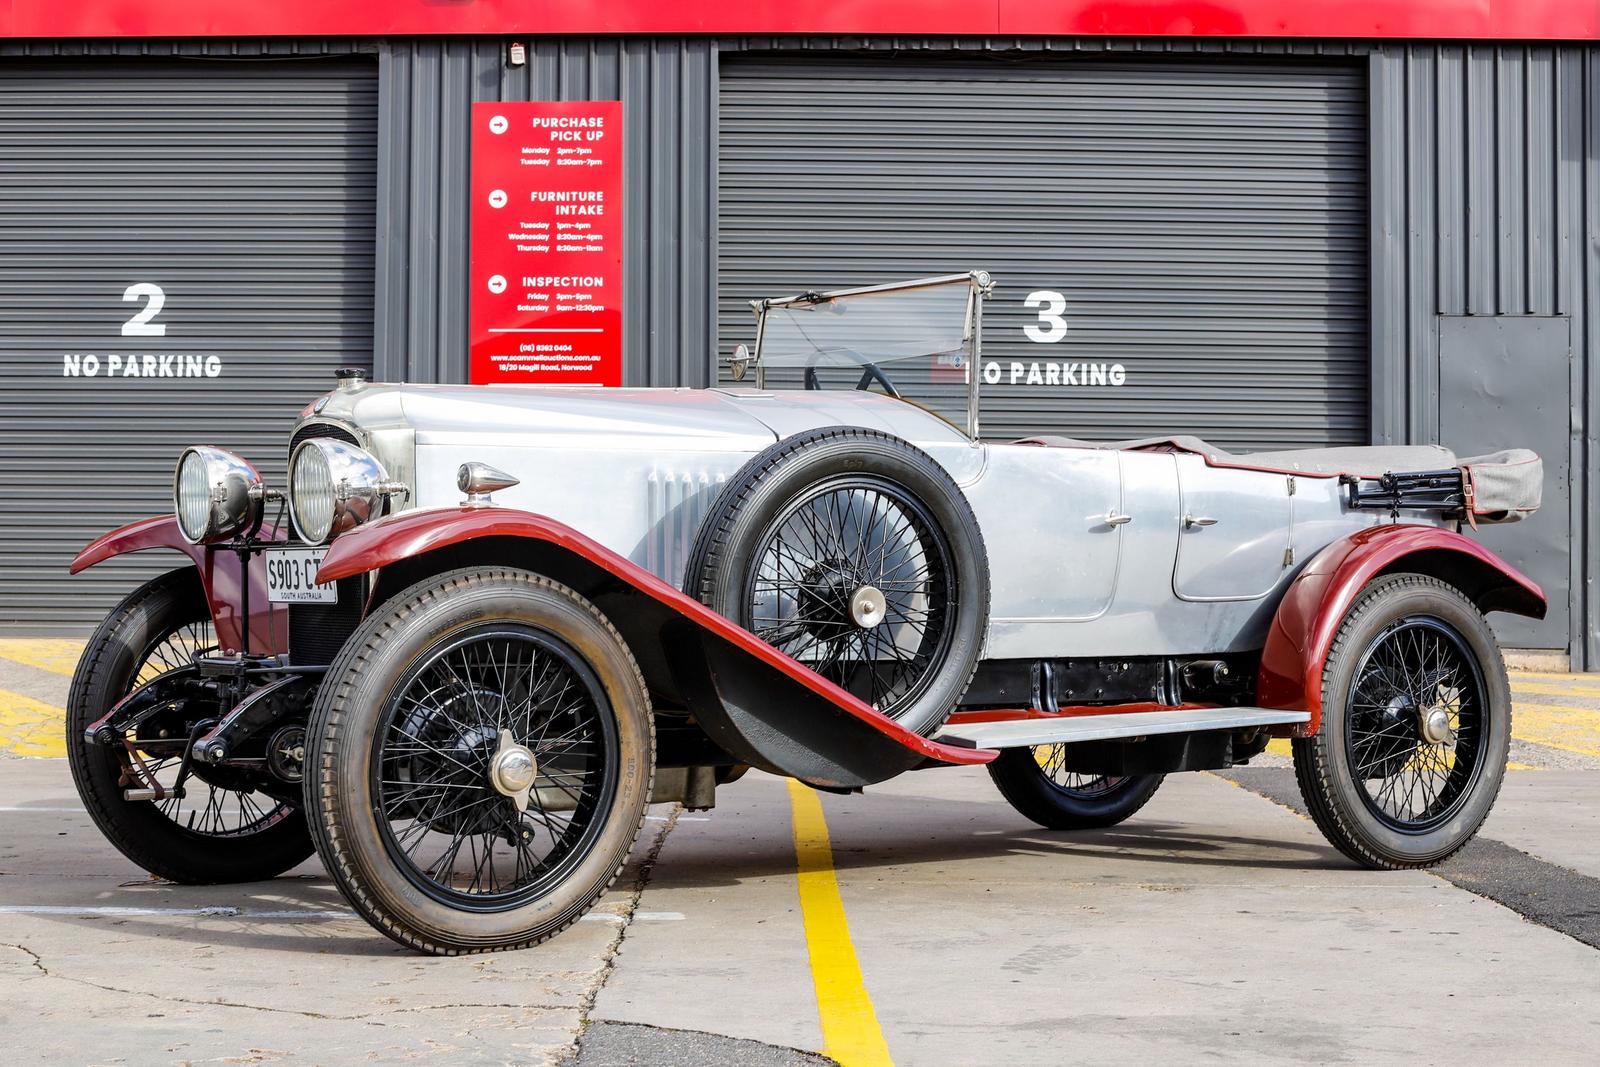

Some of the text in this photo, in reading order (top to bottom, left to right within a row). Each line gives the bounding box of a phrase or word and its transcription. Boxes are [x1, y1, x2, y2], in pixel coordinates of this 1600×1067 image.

[532, 117, 604, 128] PURCHASE
[550, 131, 604, 141] PICK UP
[521, 147, 550, 155] Monday
[520, 158, 550, 166] Tuesday
[530, 191, 604, 202] FURNITURE
[555, 205, 604, 215] INTAKE
[520, 222, 550, 230] Tuesday
[508, 233, 550, 241] Wednesday
[517, 244, 550, 253] Thursday
[522, 276, 604, 287] INSPECTION
[527, 293, 550, 301] Friday
[121, 283, 166, 336] 2
[517, 304, 550, 312] Saturday
[1023, 290, 1068, 343] 3
[63, 354, 222, 378] NO PARKING
[518, 363, 540, 373] Magill
[540, 363, 561, 372] Road,
[561, 363, 593, 371] Norwood
[1010, 363, 1126, 386] PARKING
[297, 592, 322, 600] AUSTRALIA
